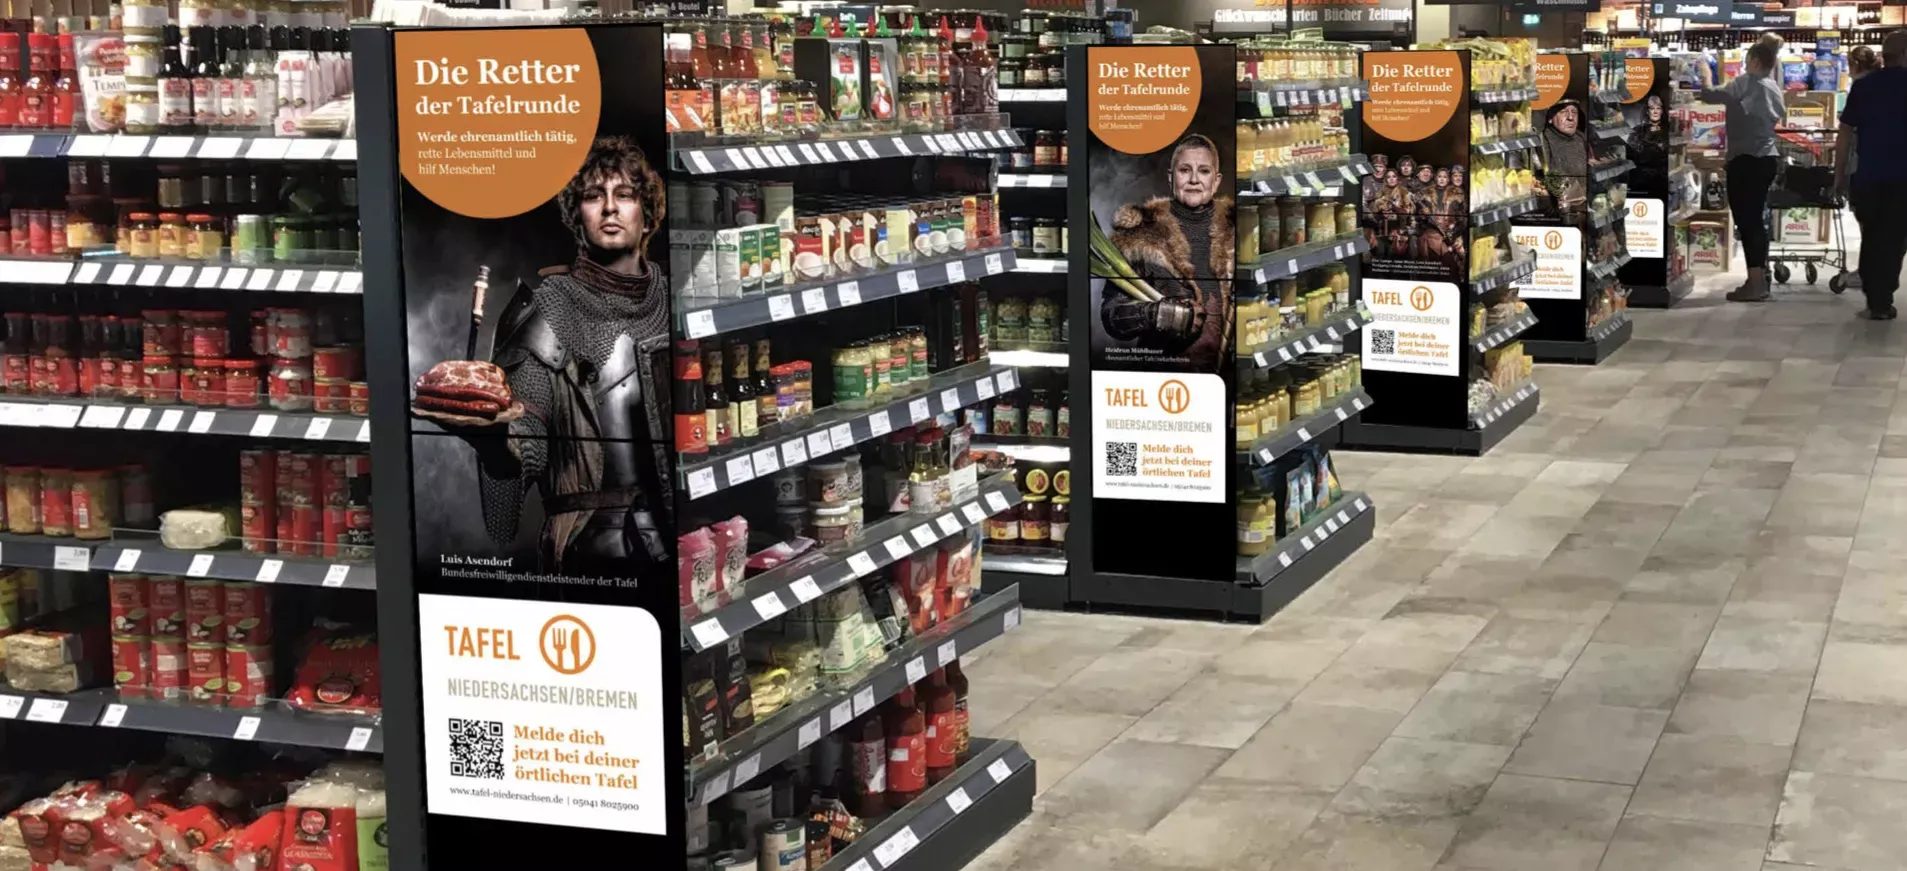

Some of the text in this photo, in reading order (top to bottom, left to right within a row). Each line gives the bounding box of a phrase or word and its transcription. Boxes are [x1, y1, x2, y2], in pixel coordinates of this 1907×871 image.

[1324, 8, 1361, 22] Bücher
[1731, 12, 1755, 20] Herren
[414, 57, 580, 86] Die Retter
[1098, 61, 1191, 79] Die Retter
[1372, 64, 1454, 78] Die Retter
[1536, 62, 1565, 72] Retter
[1098, 83, 1190, 95] der Tafelrunde
[1372, 82, 1453, 93] der Tafelrunde
[416, 94, 581, 115] der Tafelrunde
[1689, 110, 1725, 123] Persil
[1790, 109, 1803, 117] 130
[418, 130, 577, 144] Werde ehrenamtlich tätig,
[418, 146, 536, 159] rette Lebensmittel und
[418, 163, 496, 175] hilf Menschen!
[1516, 235, 1539, 246] TAFEL
[1372, 291, 1403, 306] TAFEL
[1105, 388, 1149, 408] TAFEL
[1106, 418, 1212, 433] NIEDERSACHSEN/BREMEN
[1142, 444, 1194, 454] Melde dich
[1142, 456, 1213, 467] jetzt bei deiner
[1142, 468, 1212, 479] örtlichen Tafel
[440, 554, 513, 567] Luis Asendorf
[441, 568, 638, 588] Bundesfreiwilligendienstleistender der Tafel
[444, 625, 521, 661] TAFEL
[448, 678, 638, 710] NIEDERSACHSEN/BREMEN
[513, 724, 605, 746] Melde dich
[512, 744, 640, 769] jetzt bei deiner
[515, 766, 639, 790] örtlichen Tafel
[450, 786, 564, 805] www.tafel-niedersachsen.de
[572, 797, 599, 810] 05041
[600, 798, 640, 812] 8025900
